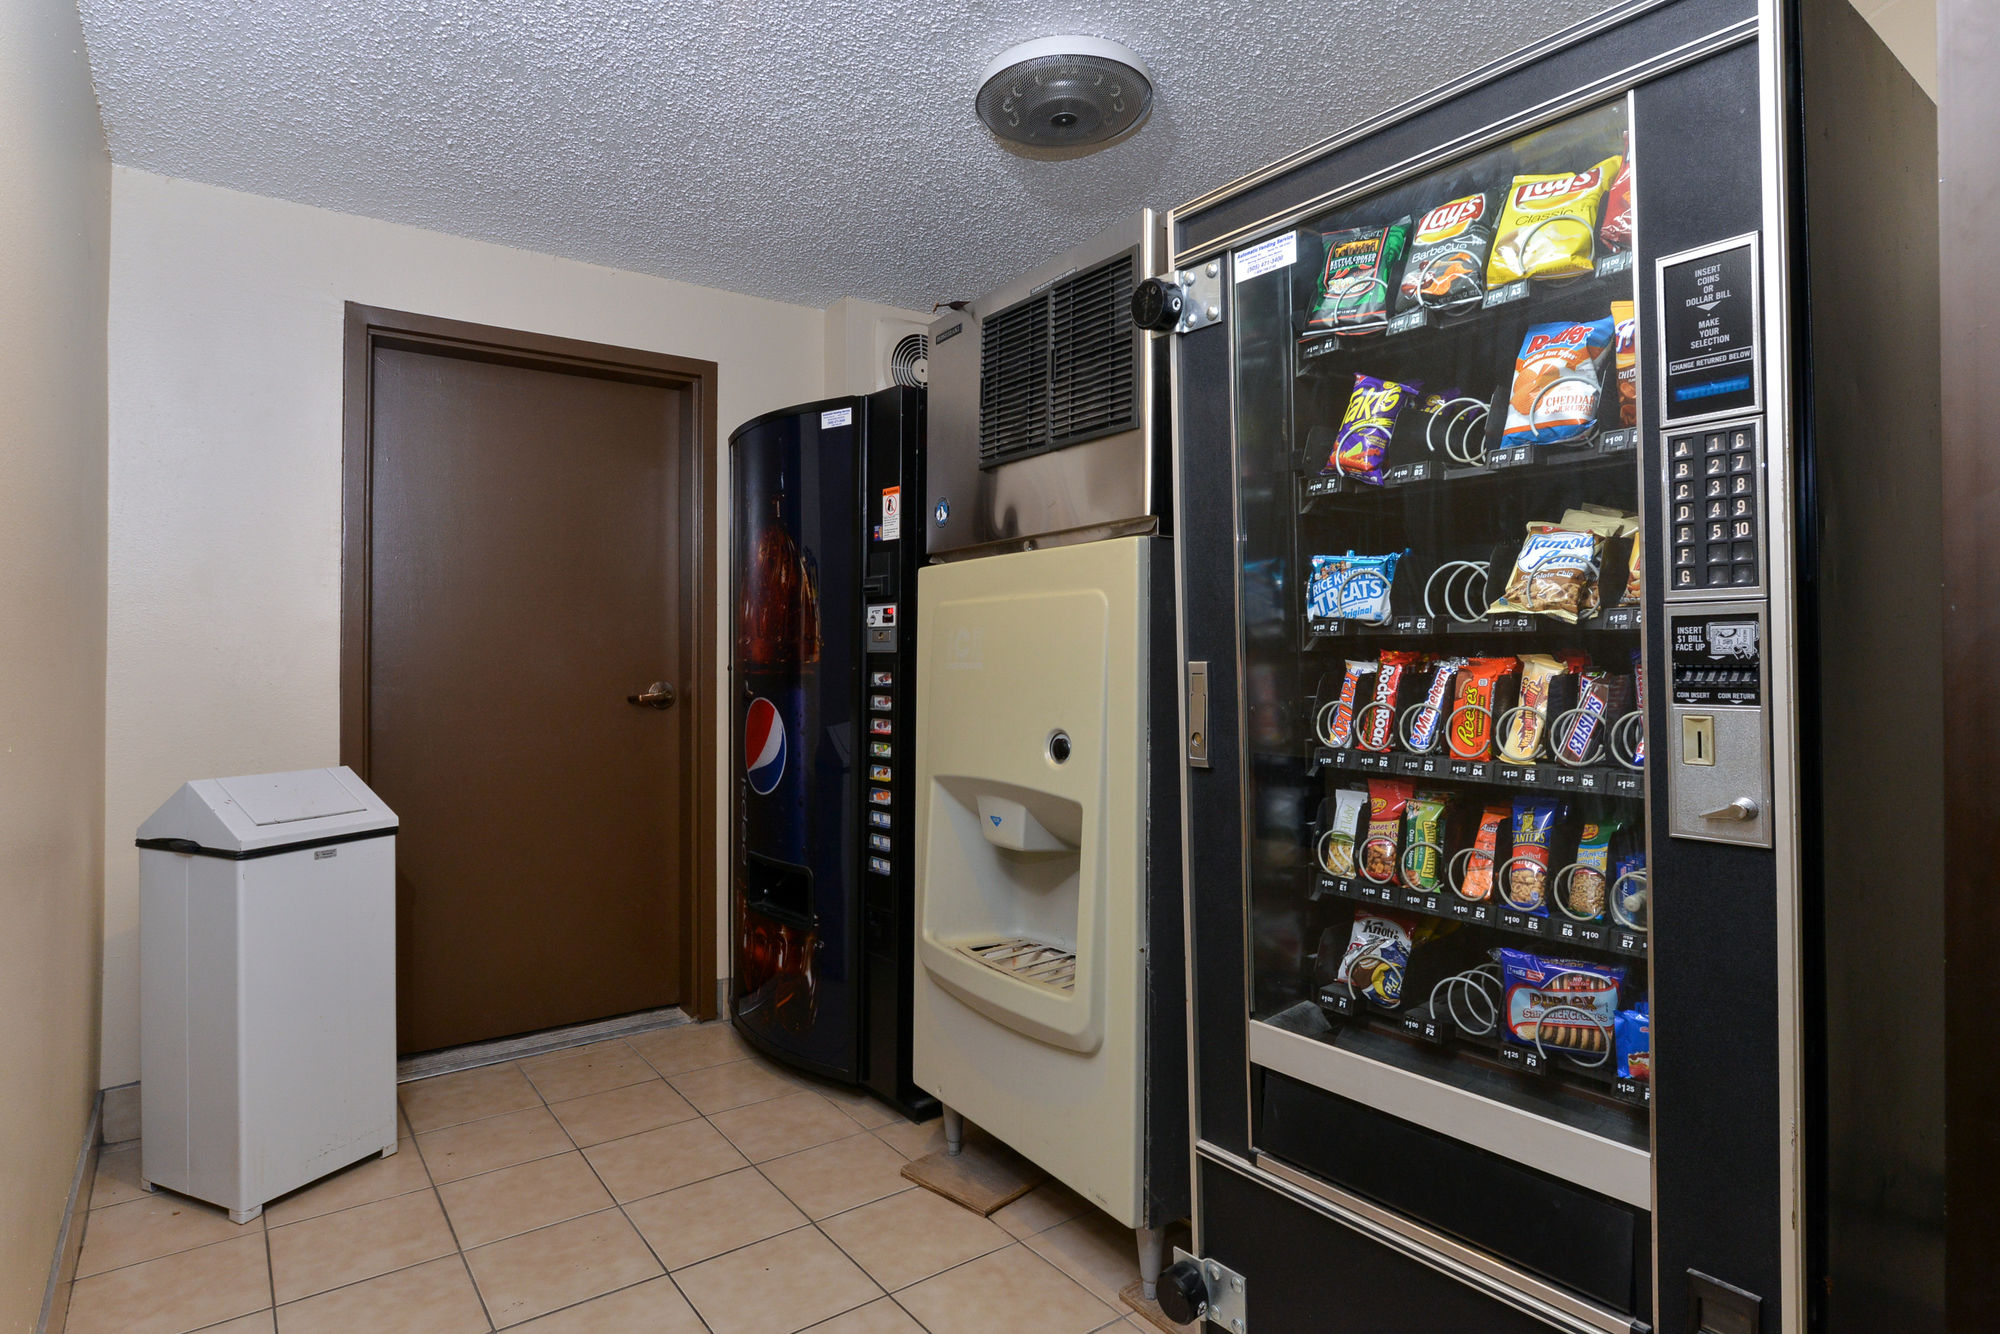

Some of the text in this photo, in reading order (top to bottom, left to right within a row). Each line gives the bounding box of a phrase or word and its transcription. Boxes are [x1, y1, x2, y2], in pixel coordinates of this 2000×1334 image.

[1694, 264, 1721, 278] INSERT
[1697, 274, 1720, 286] COINS
[1703, 284, 1714, 294] OR
[1685, 289, 1732, 307] DOLLAR BILL
[1698, 318, 1720, 329] MAKE
[1699, 327, 1720, 338] YOUR
[1690, 334, 1730, 349] SELECTION
[1671, 349, 1751, 372] CHANGE RETURNED BELOW
[1713, 437, 1718, 450] 1
[1735, 433, 1744, 446] 6
[1680, 442, 1687, 454] A
[1711, 459, 1719, 472] 2
[1736, 455, 1744, 468] 7
[1680, 463, 1688, 475] B
[1680, 484, 1688, 497] C
[1712, 481, 1720, 494] 3
[1736, 477, 1745, 491] 8
[1680, 505, 1688, 519] D
[1712, 502, 1720, 515] 4
[1737, 500, 1745, 513] 9
[1681, 527, 1688, 541] E
[1713, 524, 1721, 538] 5
[1735, 522, 1749, 536] 10
[1681, 548, 1689, 561] F
[1681, 570, 1690, 583] G
[1312, 580, 1334, 597] RICE
[1313, 579, 1382, 617] TREATS
[1517, 618, 1528, 627] C3
[1676, 626, 1703, 635] INSERT
[1677, 635, 1703, 643] $1 BILL
[1675, 643, 1706, 652] FACE UP
[1457, 685, 1478, 747] Reee's
[1525, 773, 1536, 781] D5
[1582, 779, 1594, 787] D6
[1475, 911, 1485, 919] E4
[1528, 921, 1538, 930] E5
[1562, 928, 1573, 936] E6
[1622, 940, 1634, 948] E7
[1425, 1028, 1435, 1036] F2
[1526, 1058, 1537, 1067] F3
